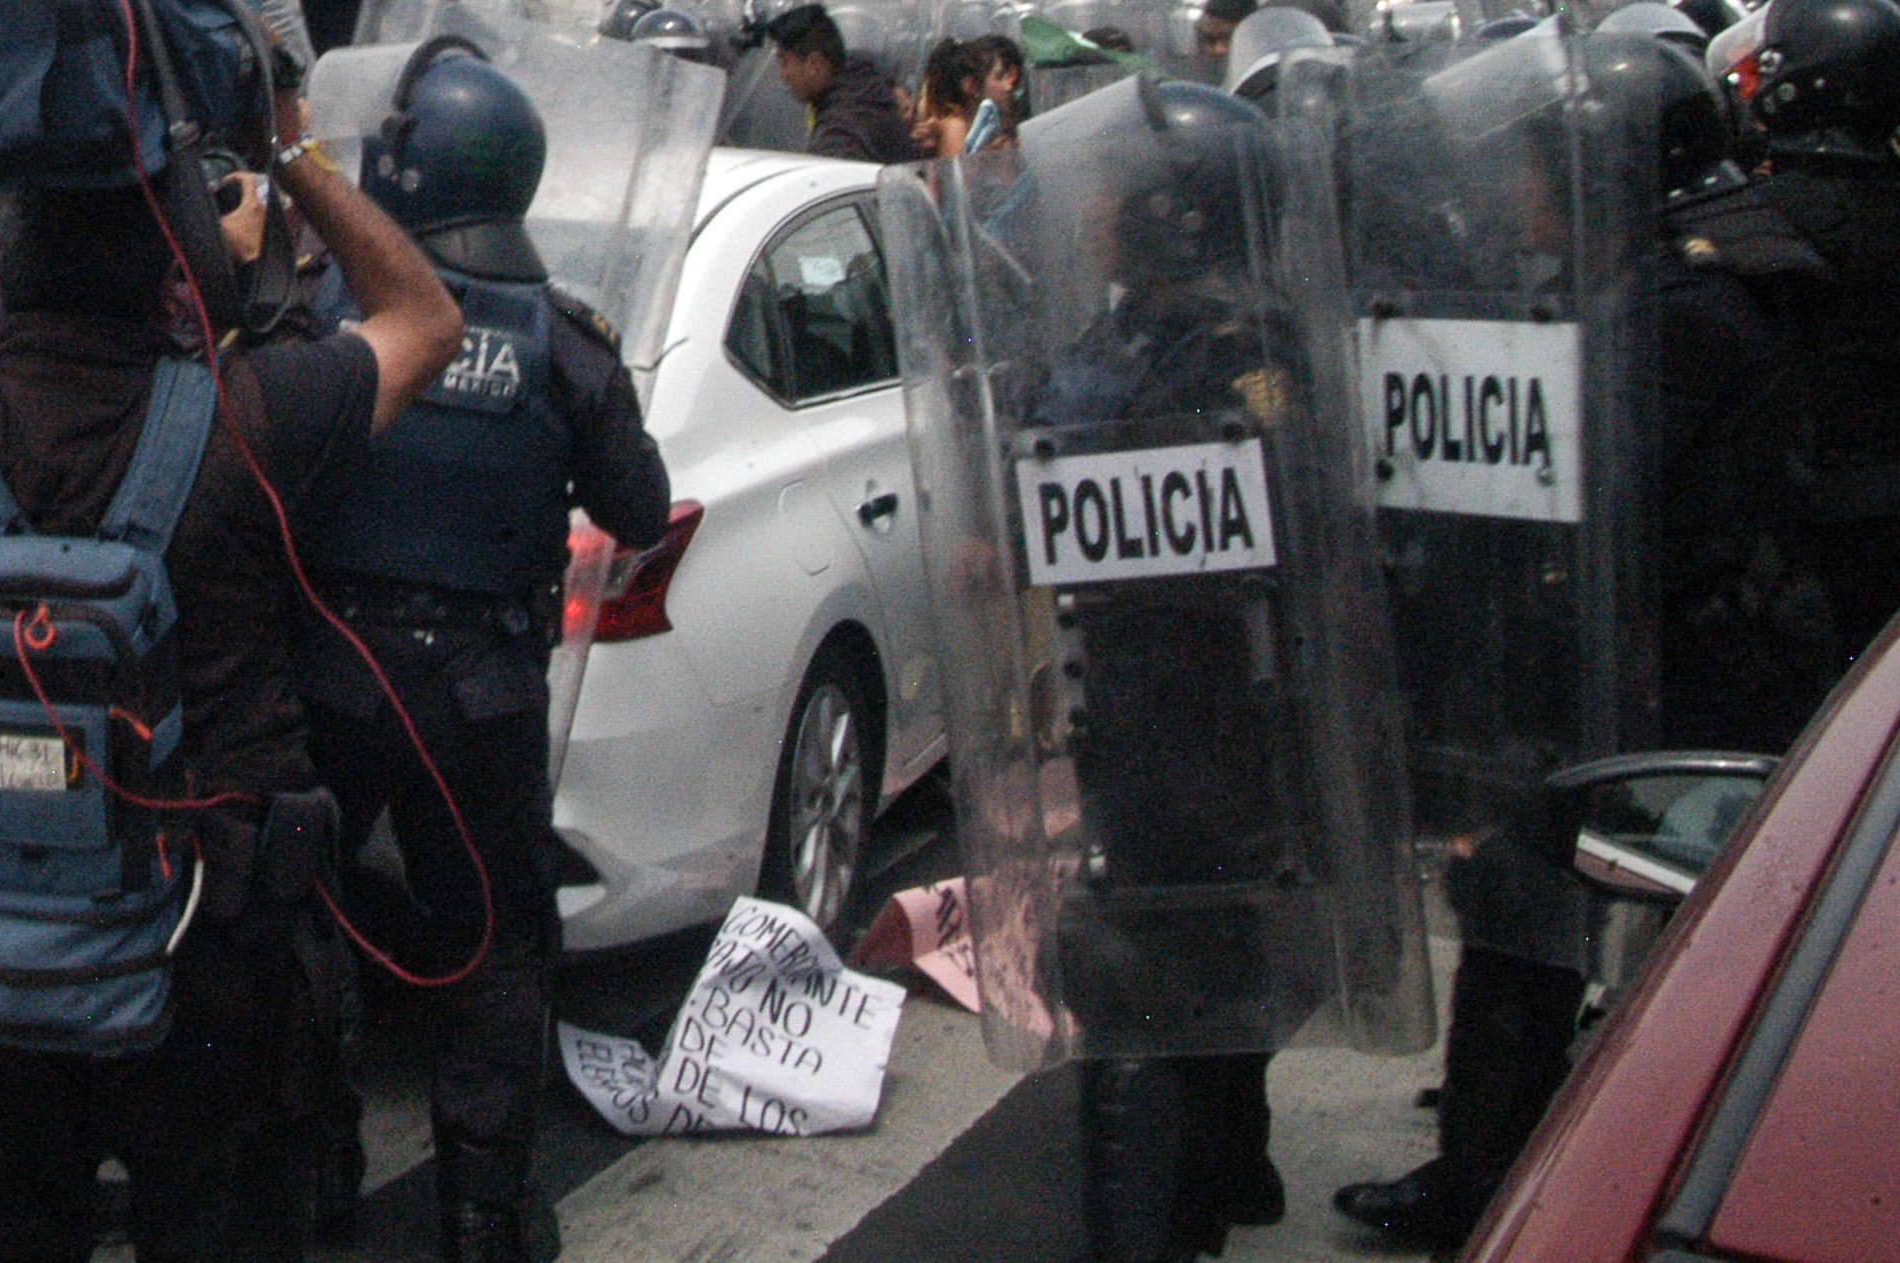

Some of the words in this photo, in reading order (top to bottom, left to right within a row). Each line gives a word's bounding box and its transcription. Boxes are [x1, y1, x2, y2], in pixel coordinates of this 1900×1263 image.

[1383, 372, 1553, 469] POLICIA
[702, 988, 823, 1074] BASTA
[674, 1058, 721, 1108] DE
